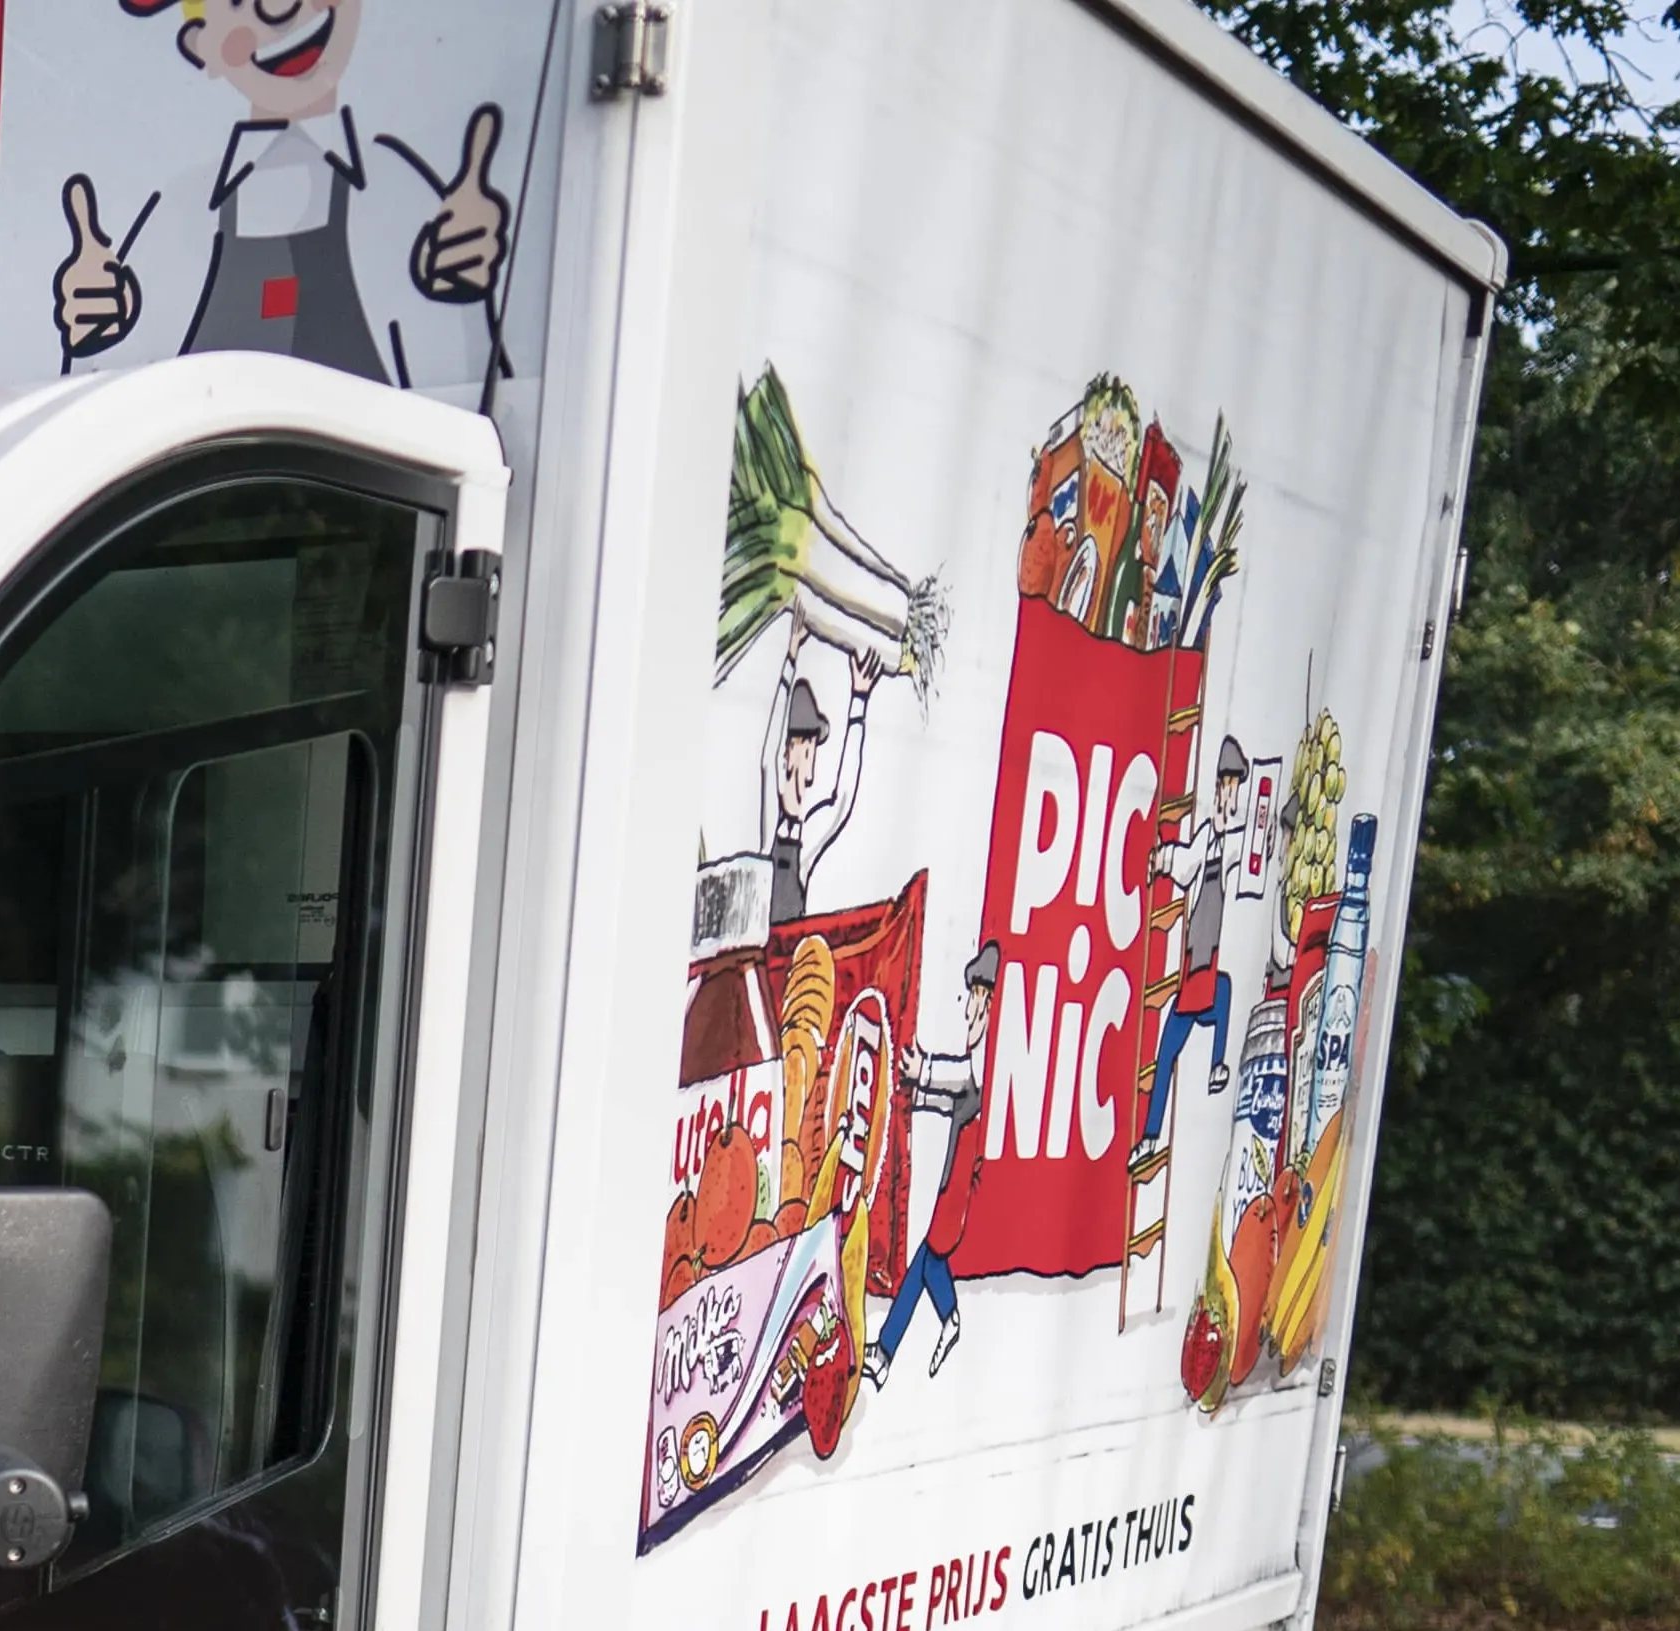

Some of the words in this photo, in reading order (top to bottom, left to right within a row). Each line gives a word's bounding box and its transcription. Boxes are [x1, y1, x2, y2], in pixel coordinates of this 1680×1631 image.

[1010, 730, 1158, 951] PIC
[1316, 1030, 1351, 1071] SPA
[657, 1285, 742, 1405] Milka
[926, 1546, 1011, 1631] PRIJS
[1022, 1517, 1118, 1601] GRATIS
[1124, 1494, 1195, 1569] THUIS
